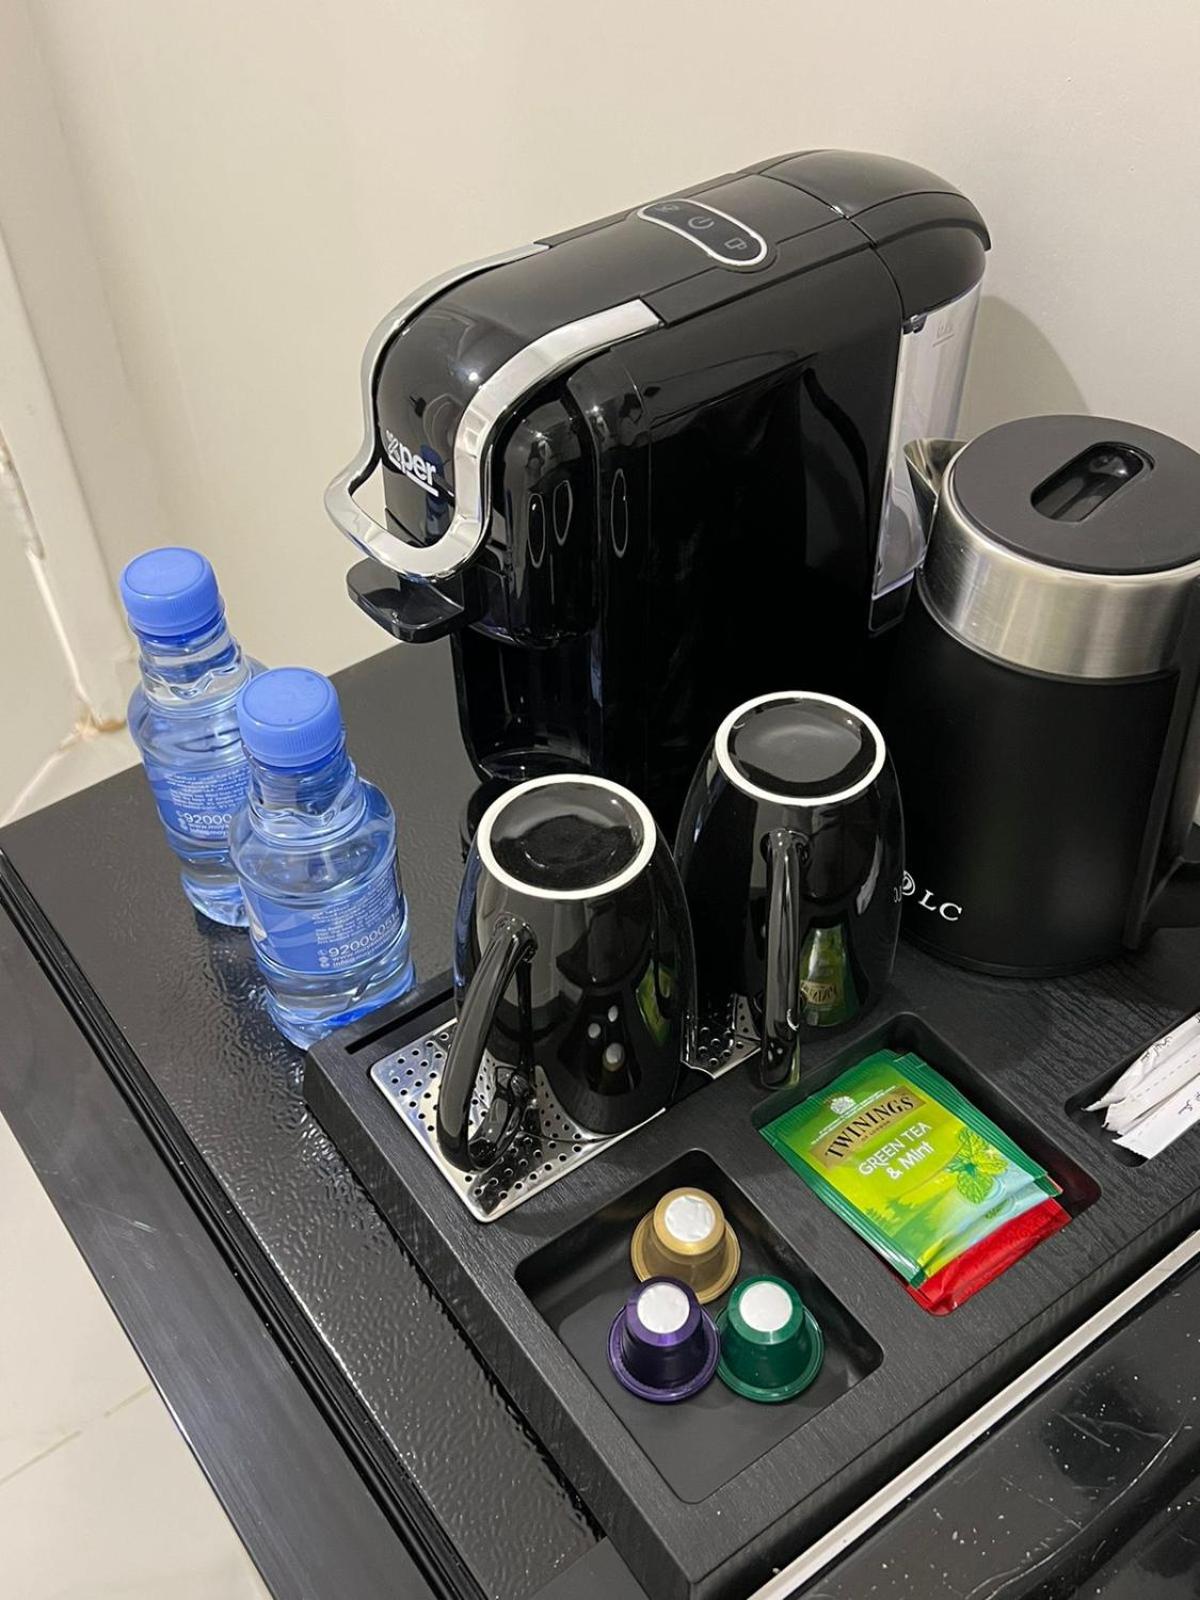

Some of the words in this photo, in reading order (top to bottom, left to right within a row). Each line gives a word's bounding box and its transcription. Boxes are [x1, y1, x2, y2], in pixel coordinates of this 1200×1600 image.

[824, 1096, 914, 1158] TWININGS
[858, 1138, 906, 1176] GREEN
[901, 1122, 932, 1142] TEA
[886, 1166, 903, 1180] &
